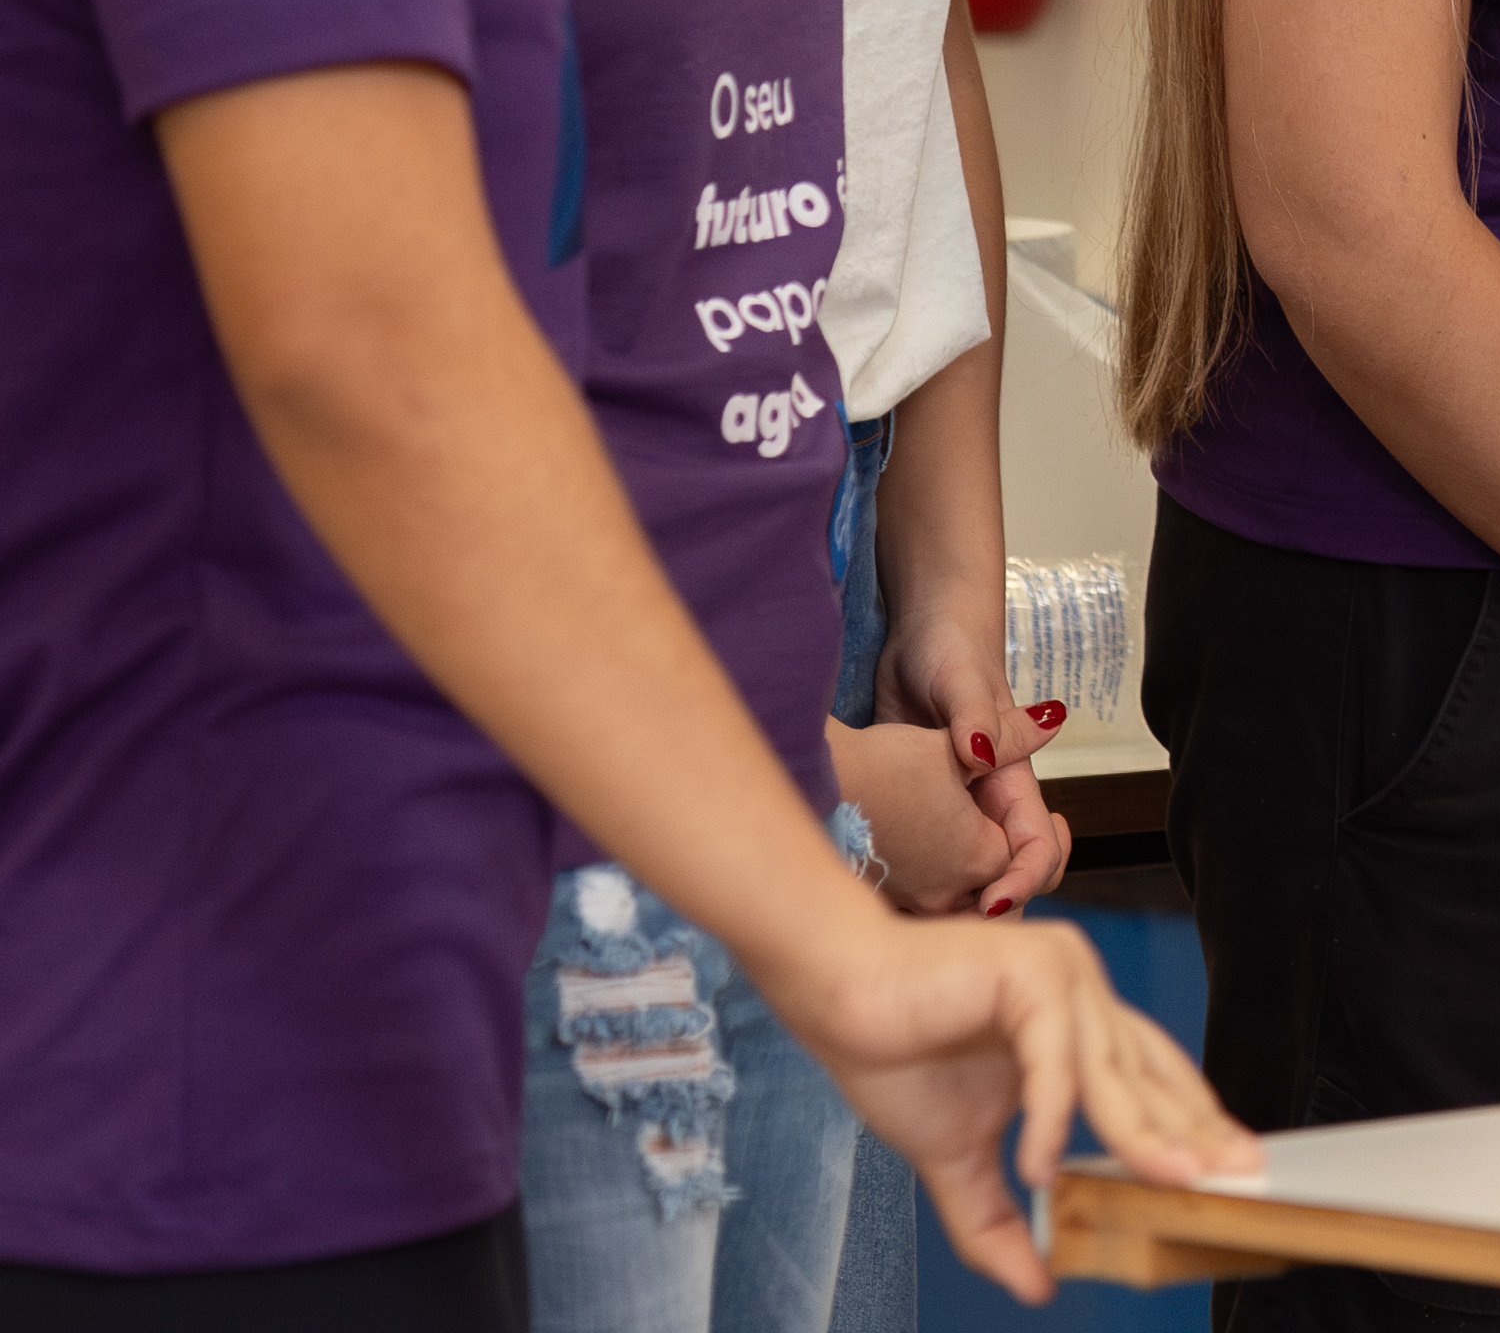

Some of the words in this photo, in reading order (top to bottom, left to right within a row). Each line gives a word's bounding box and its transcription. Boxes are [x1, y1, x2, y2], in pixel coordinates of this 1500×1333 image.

[710, 72, 739, 140] O
[744, 76, 794, 134] seu
[694, 181, 831, 250] futuro
